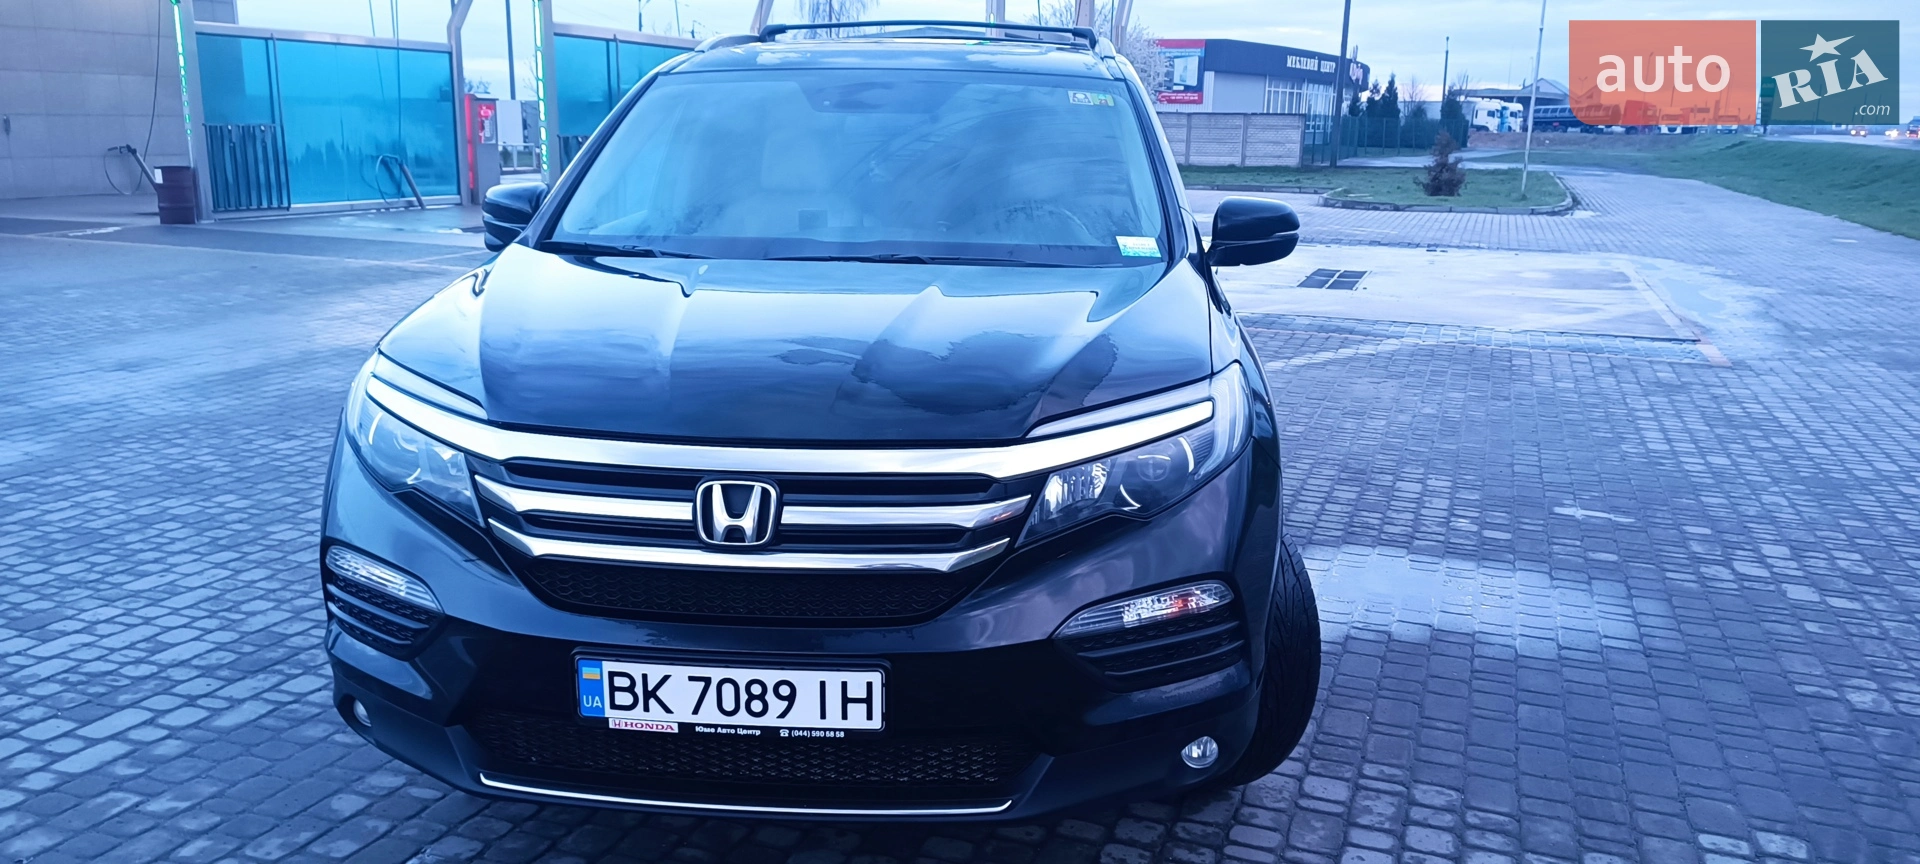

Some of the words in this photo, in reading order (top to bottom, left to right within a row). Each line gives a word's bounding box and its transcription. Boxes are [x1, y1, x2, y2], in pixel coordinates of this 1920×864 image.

[1320, 60, 1336, 74] ЦЕНТР
[583, 695, 603, 708] UA
[607, 671, 675, 714] BK
[687, 675, 797, 719] 7089
[819, 680, 874, 721] IH
[624, 721, 675, 732] HONDA
[737, 728, 761, 736] Центр
[791, 730, 811, 738] (044)
